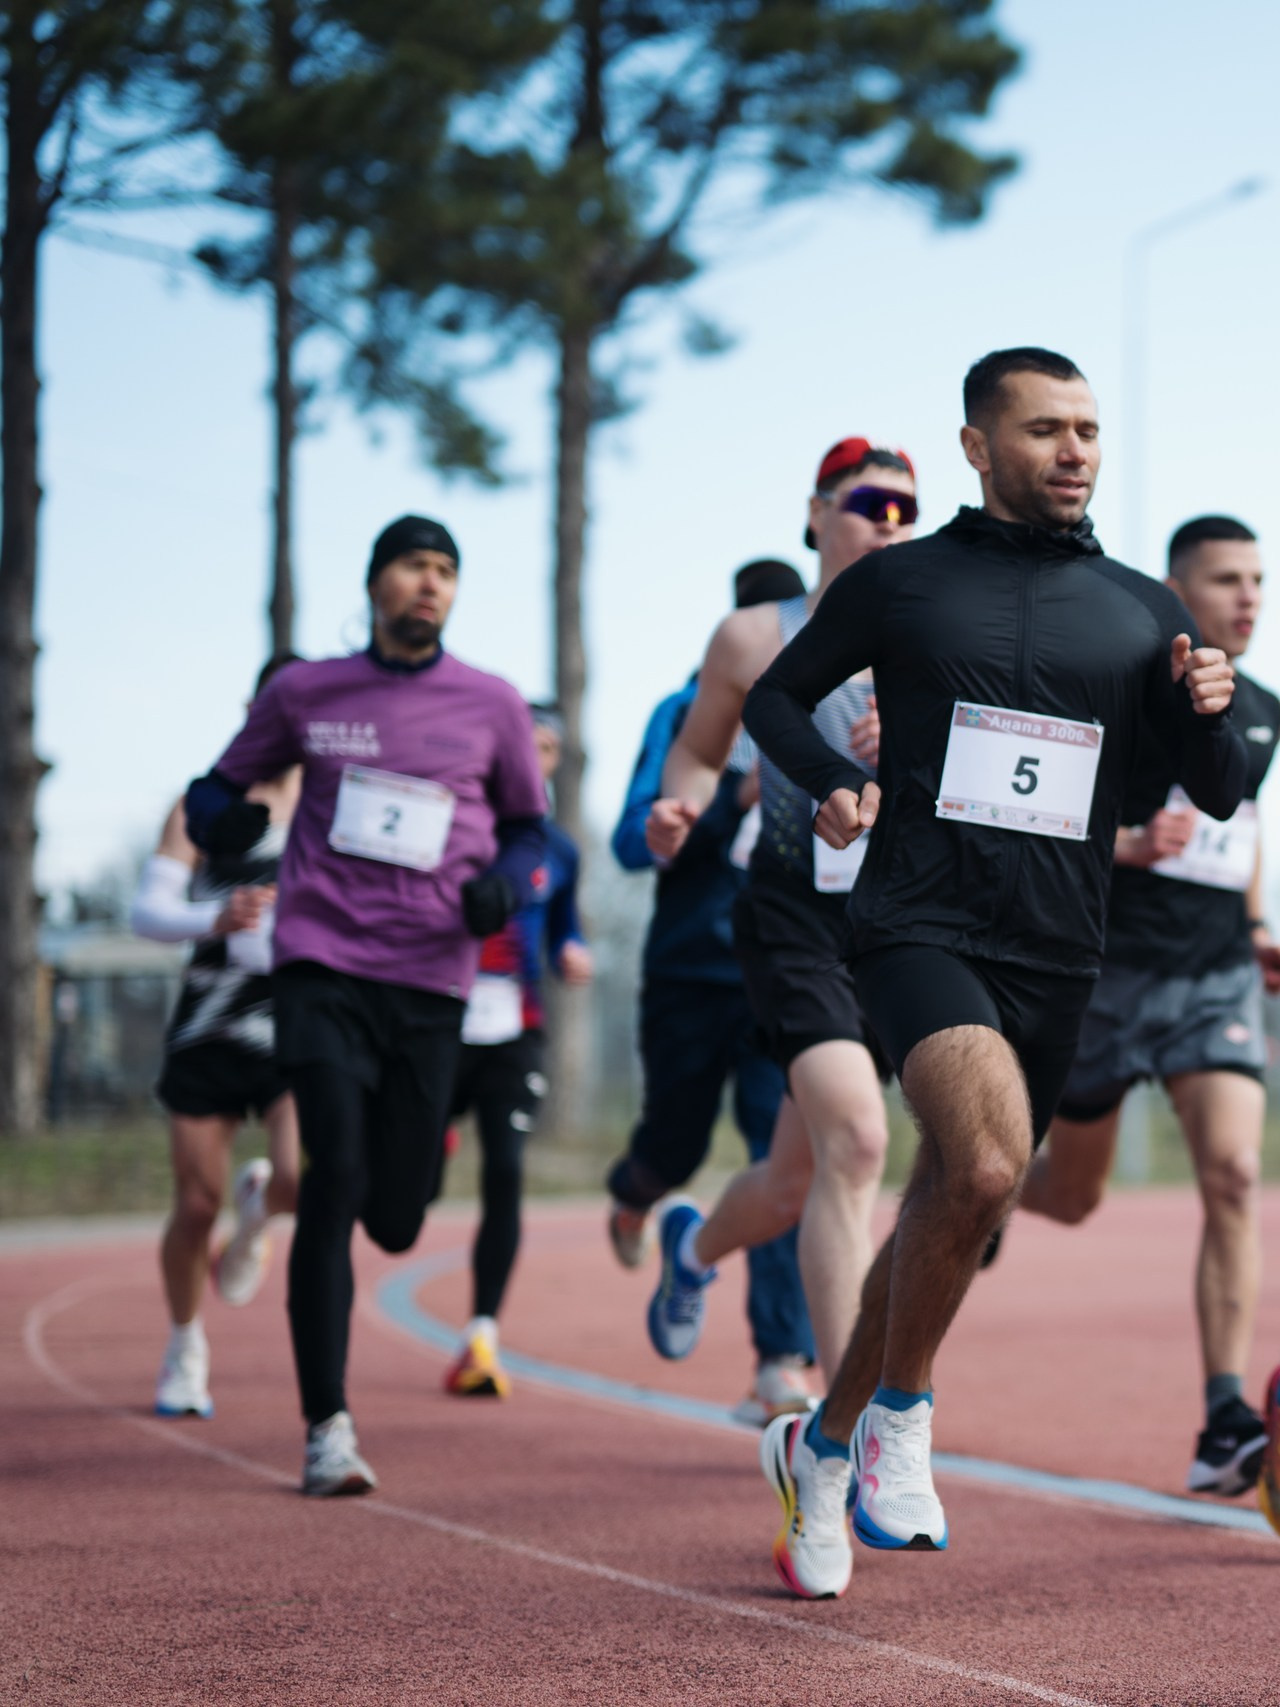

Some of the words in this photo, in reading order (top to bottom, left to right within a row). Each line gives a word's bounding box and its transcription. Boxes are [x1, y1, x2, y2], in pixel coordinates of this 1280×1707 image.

[989, 715, 1042, 735] Анапа
[1047, 724, 1085, 742] 3000
[1011, 756, 1040, 795] 5
[381, 805, 401, 835] 2
